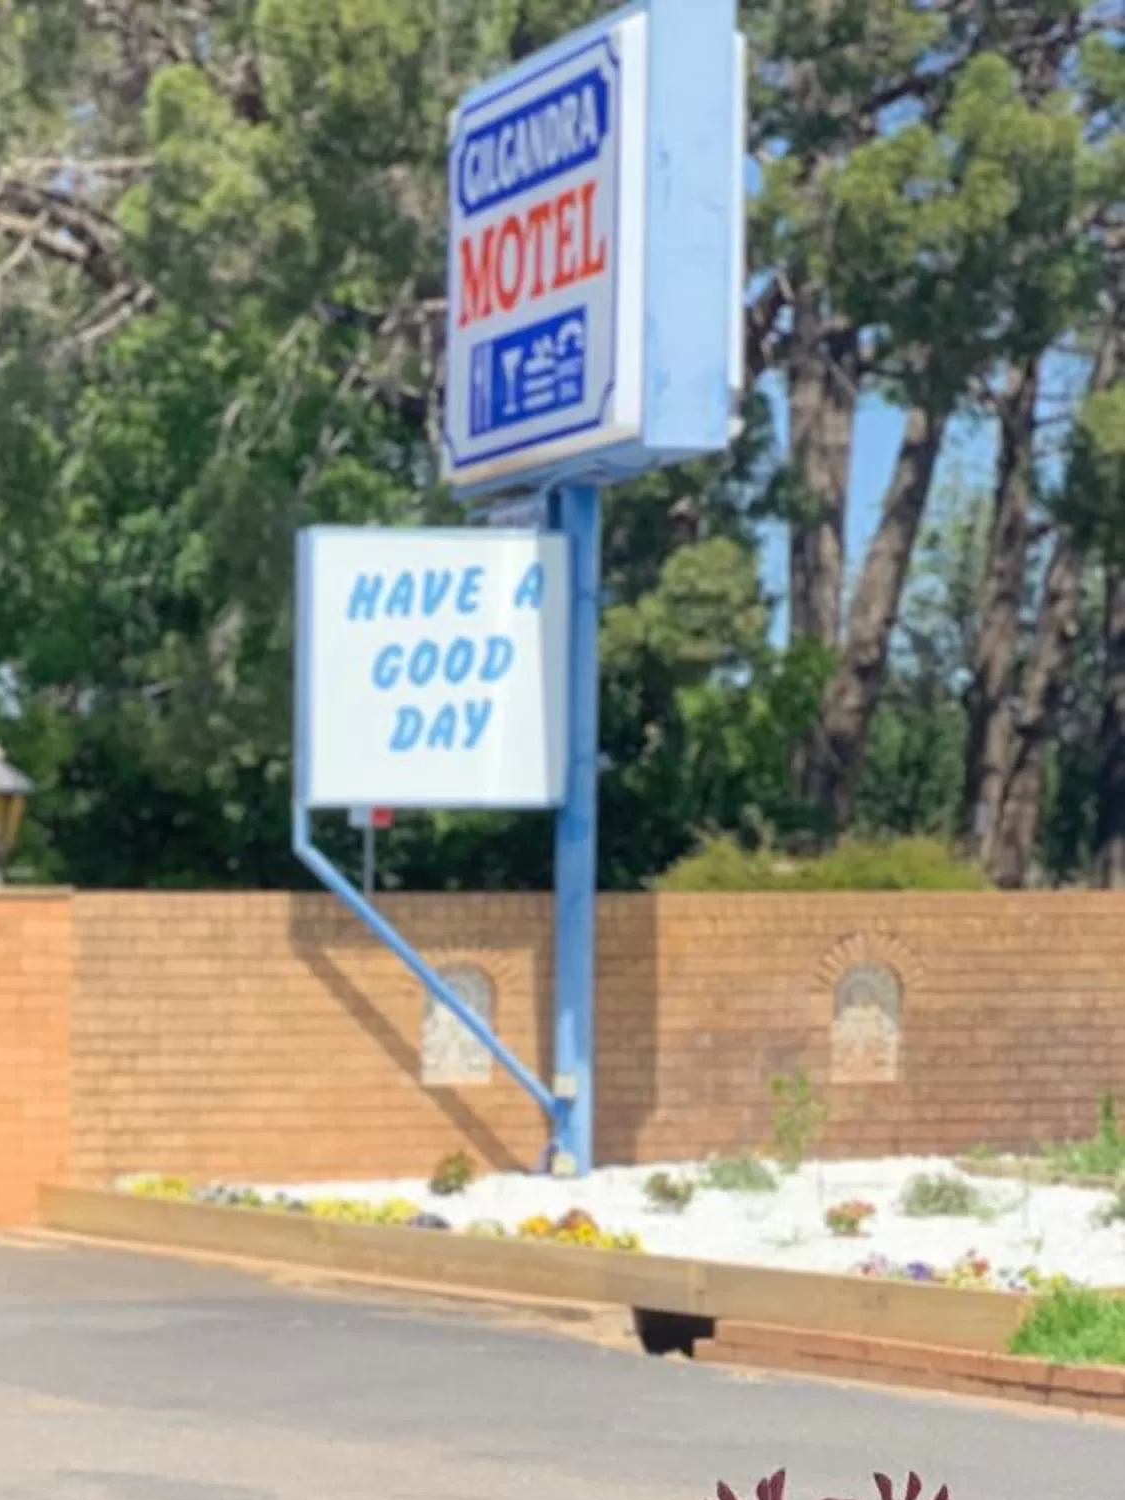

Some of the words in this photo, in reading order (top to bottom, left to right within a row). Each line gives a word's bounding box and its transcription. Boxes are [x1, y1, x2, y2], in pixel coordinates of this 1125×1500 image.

[464, 84, 598, 204] GILGANDRA
[458, 180, 606, 328] MOTEL
[347, 565, 485, 621] HAVE
[514, 562, 545, 609] A
[372, 635, 515, 690] GOOD
[389, 697, 492, 752] DAY
